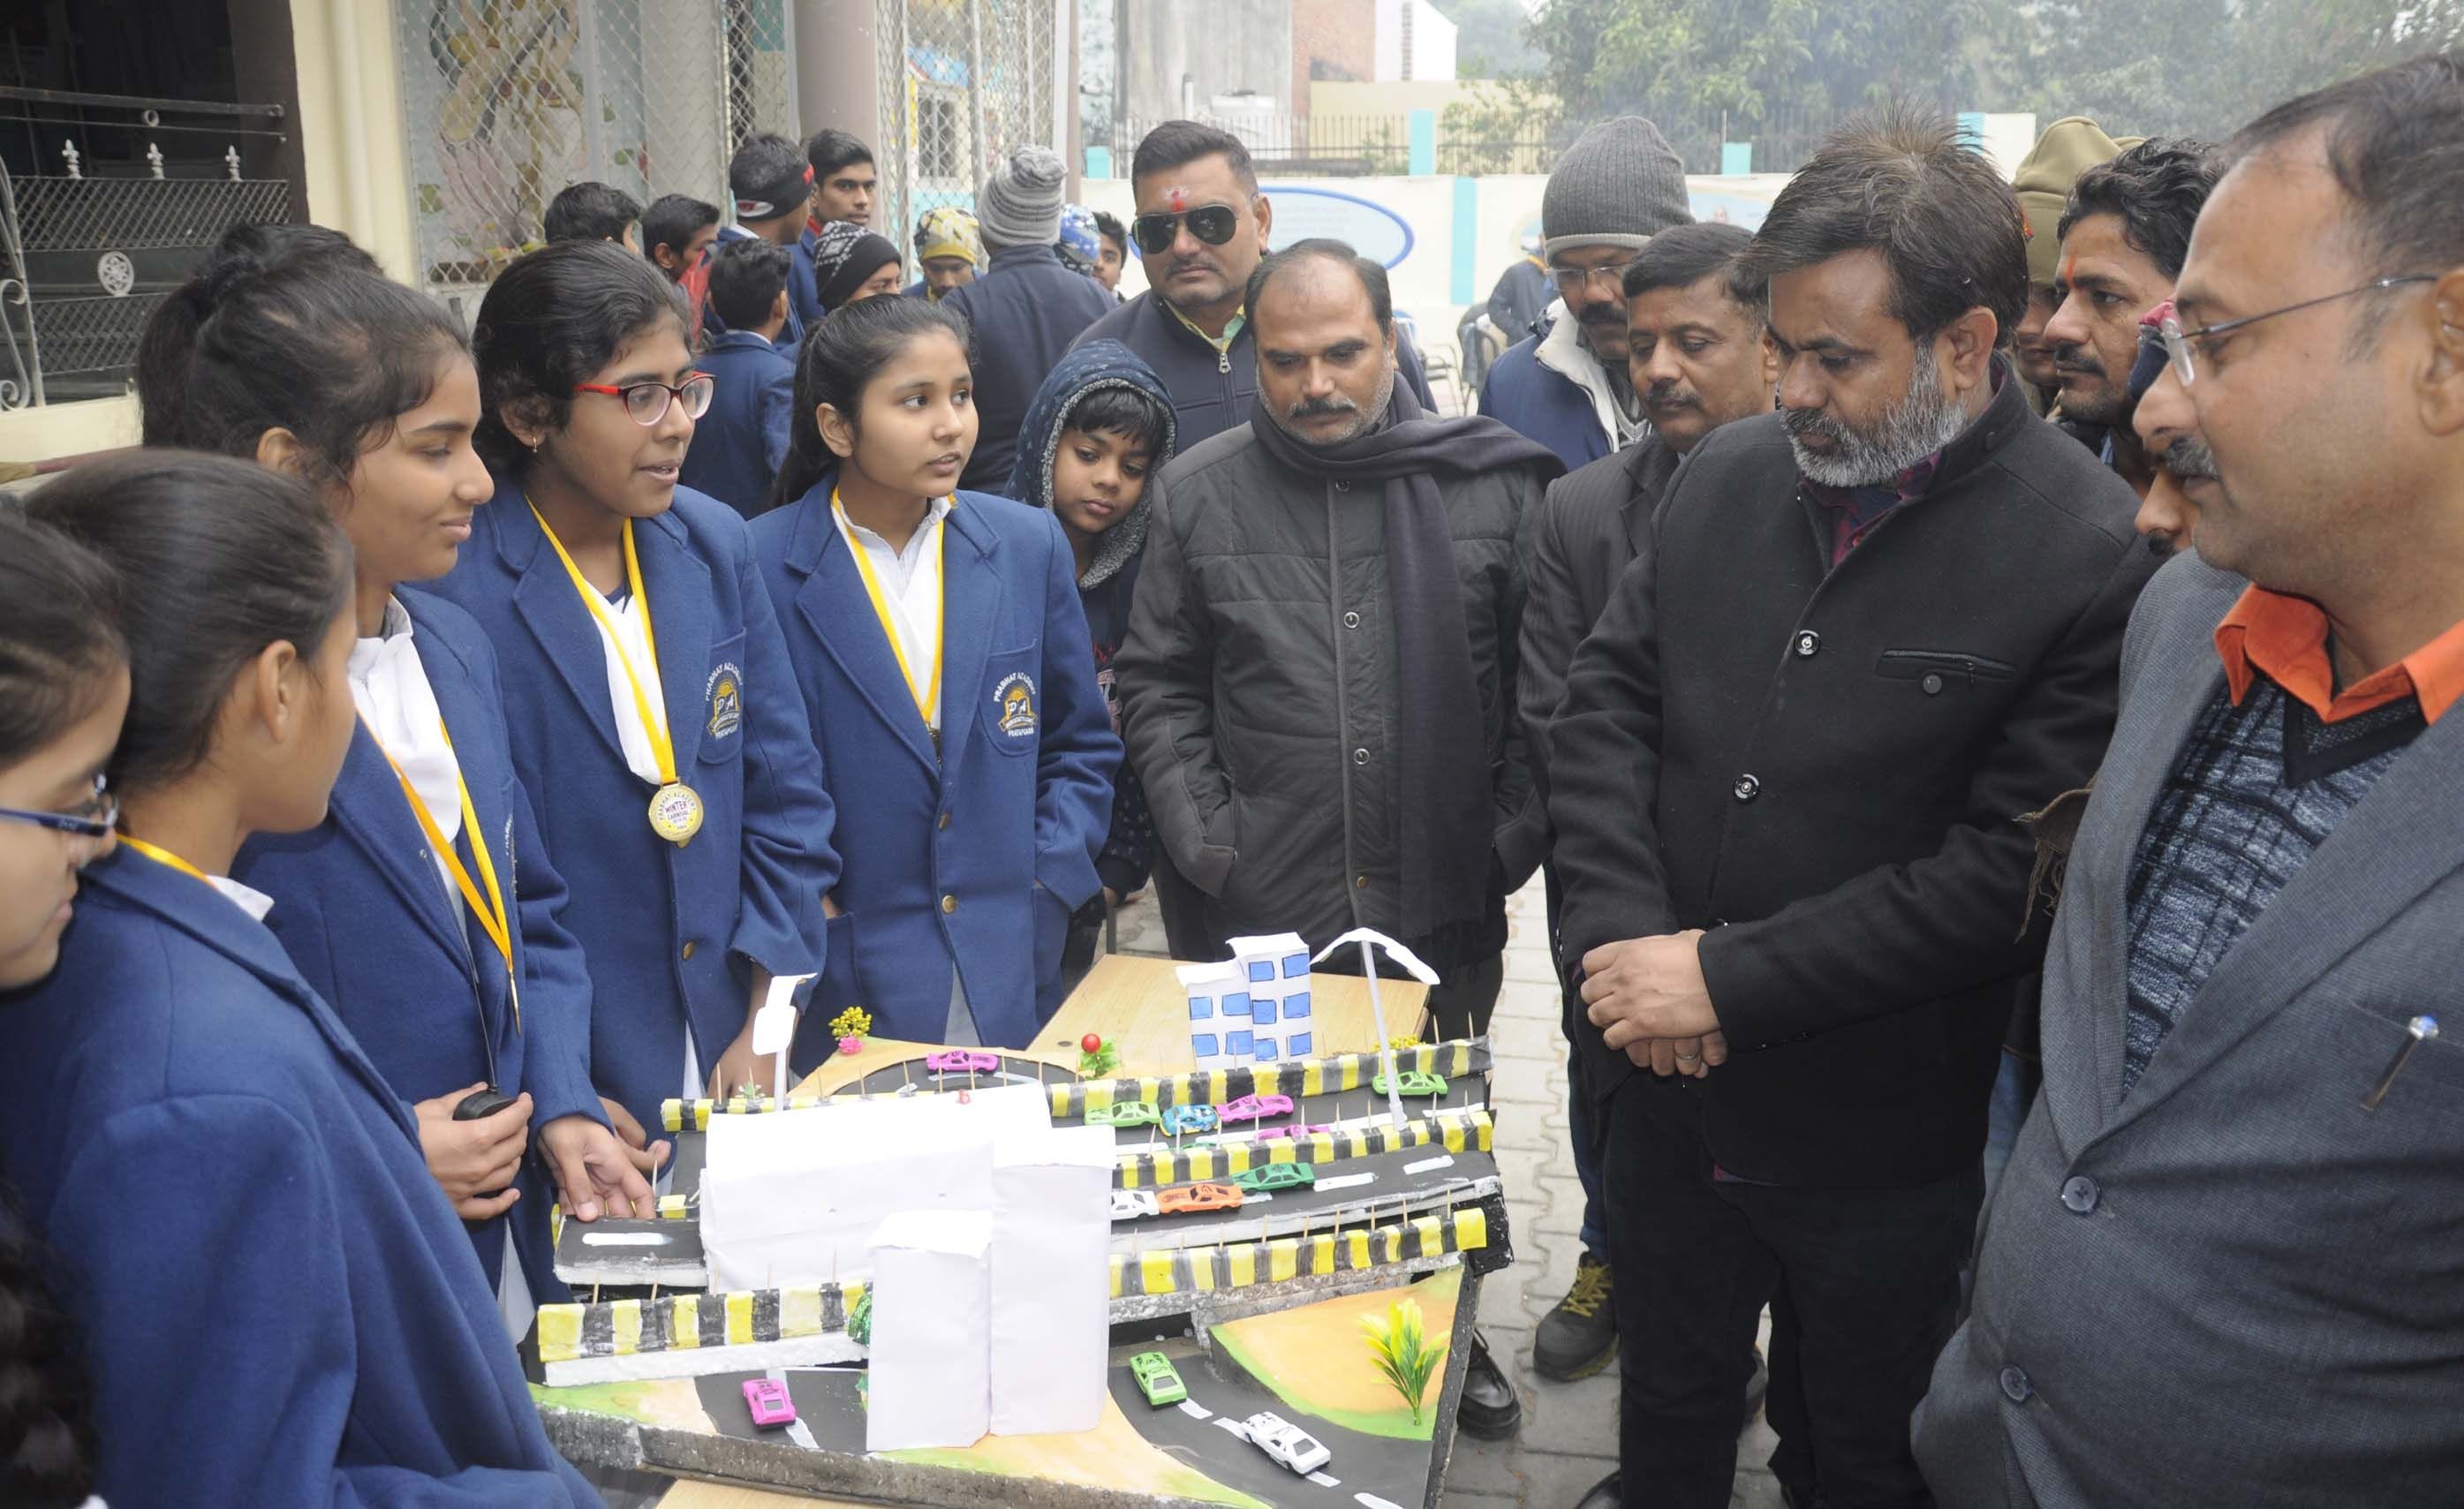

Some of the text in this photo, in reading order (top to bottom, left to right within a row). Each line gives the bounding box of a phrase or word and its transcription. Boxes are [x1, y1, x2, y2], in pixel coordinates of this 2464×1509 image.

[706, 663, 722, 701] PRABHAT
[994, 672, 1017, 702] PRABHAT
[664, 800, 688, 813] WINTER
[667, 810, 689, 820] CARNIVAL
